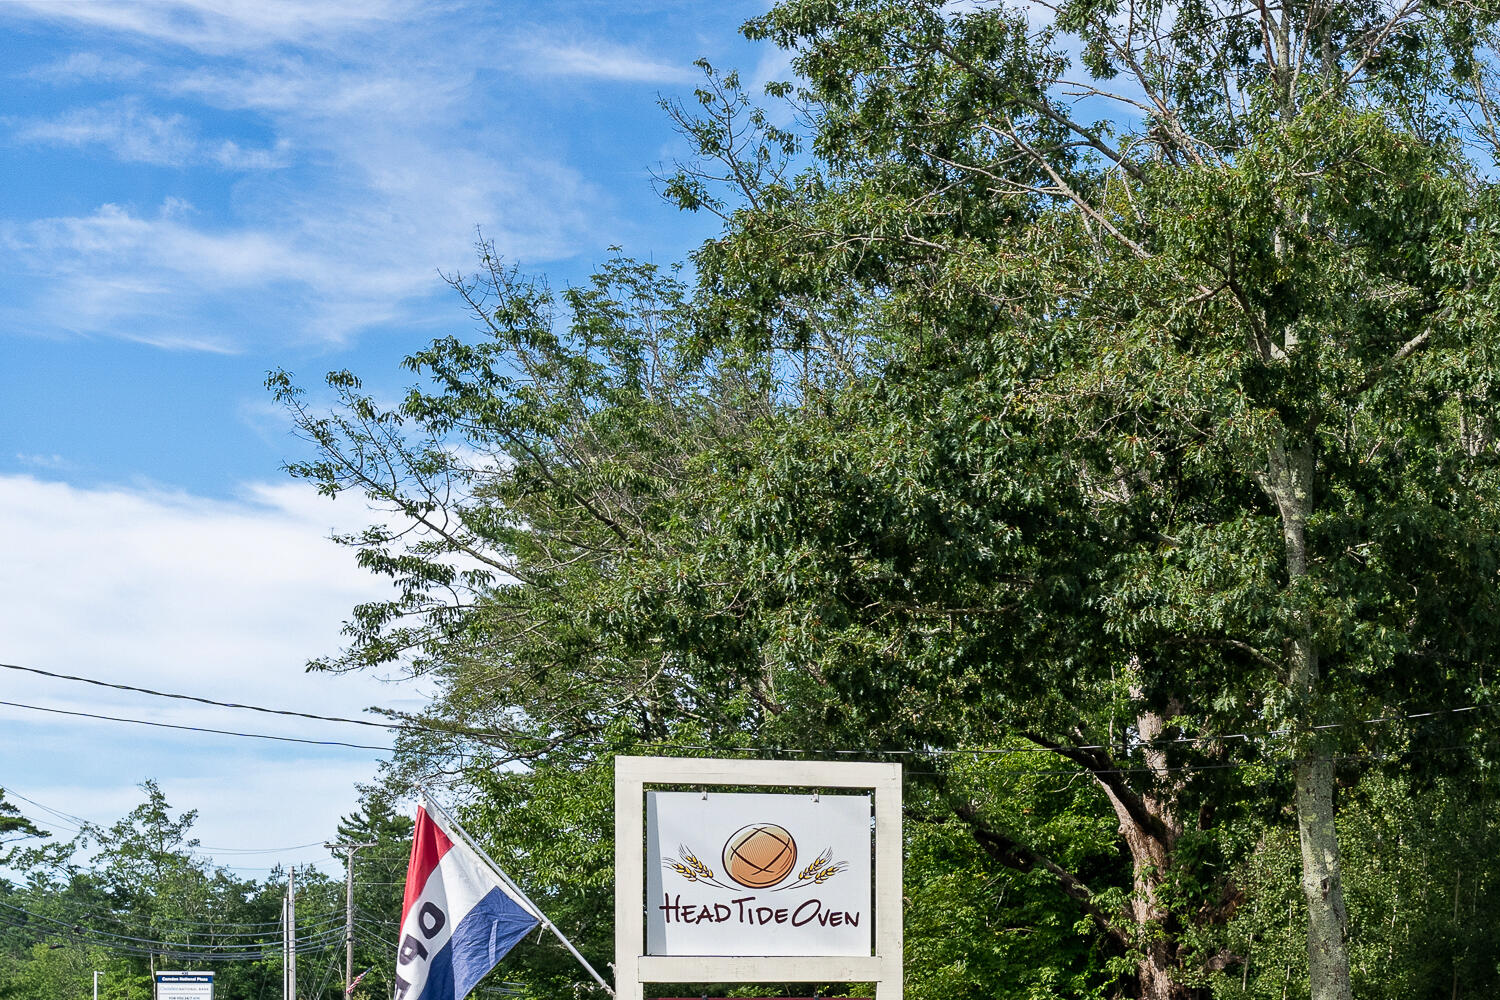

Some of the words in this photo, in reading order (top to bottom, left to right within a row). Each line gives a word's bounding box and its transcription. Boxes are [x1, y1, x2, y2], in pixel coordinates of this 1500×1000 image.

[659, 893, 731, 925] HEAD
[732, 896, 788, 926] TIDE
[791, 899, 860, 928] OVEN
